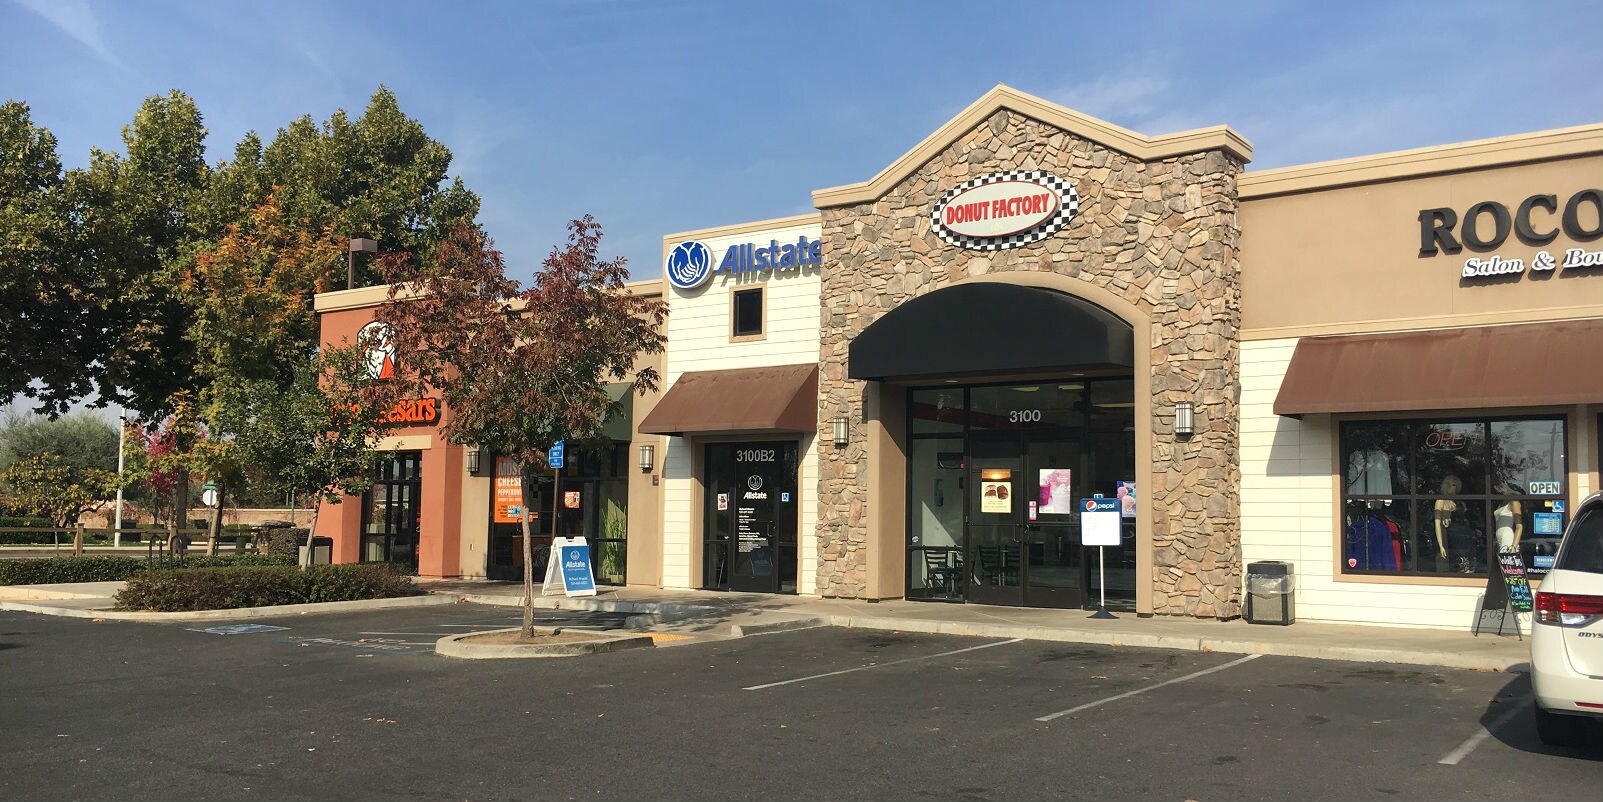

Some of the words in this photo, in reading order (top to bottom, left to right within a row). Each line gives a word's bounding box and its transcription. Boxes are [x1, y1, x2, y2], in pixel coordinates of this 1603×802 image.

[946, 201, 990, 225] DONUT
[992, 193, 1050, 219] FACTORY
[1418, 188, 1603, 258] ROCO
[716, 235, 822, 275] Allstate
[1462, 255, 1525, 277] Salon
[1532, 250, 1556, 271] &
[1009, 409, 1041, 423] 3100
[736, 449, 775, 462] 3100B2
[1531, 483, 1559, 493] OPEN
[743, 491, 768, 500] Allstate
[565, 561, 586, 569] Allstate
